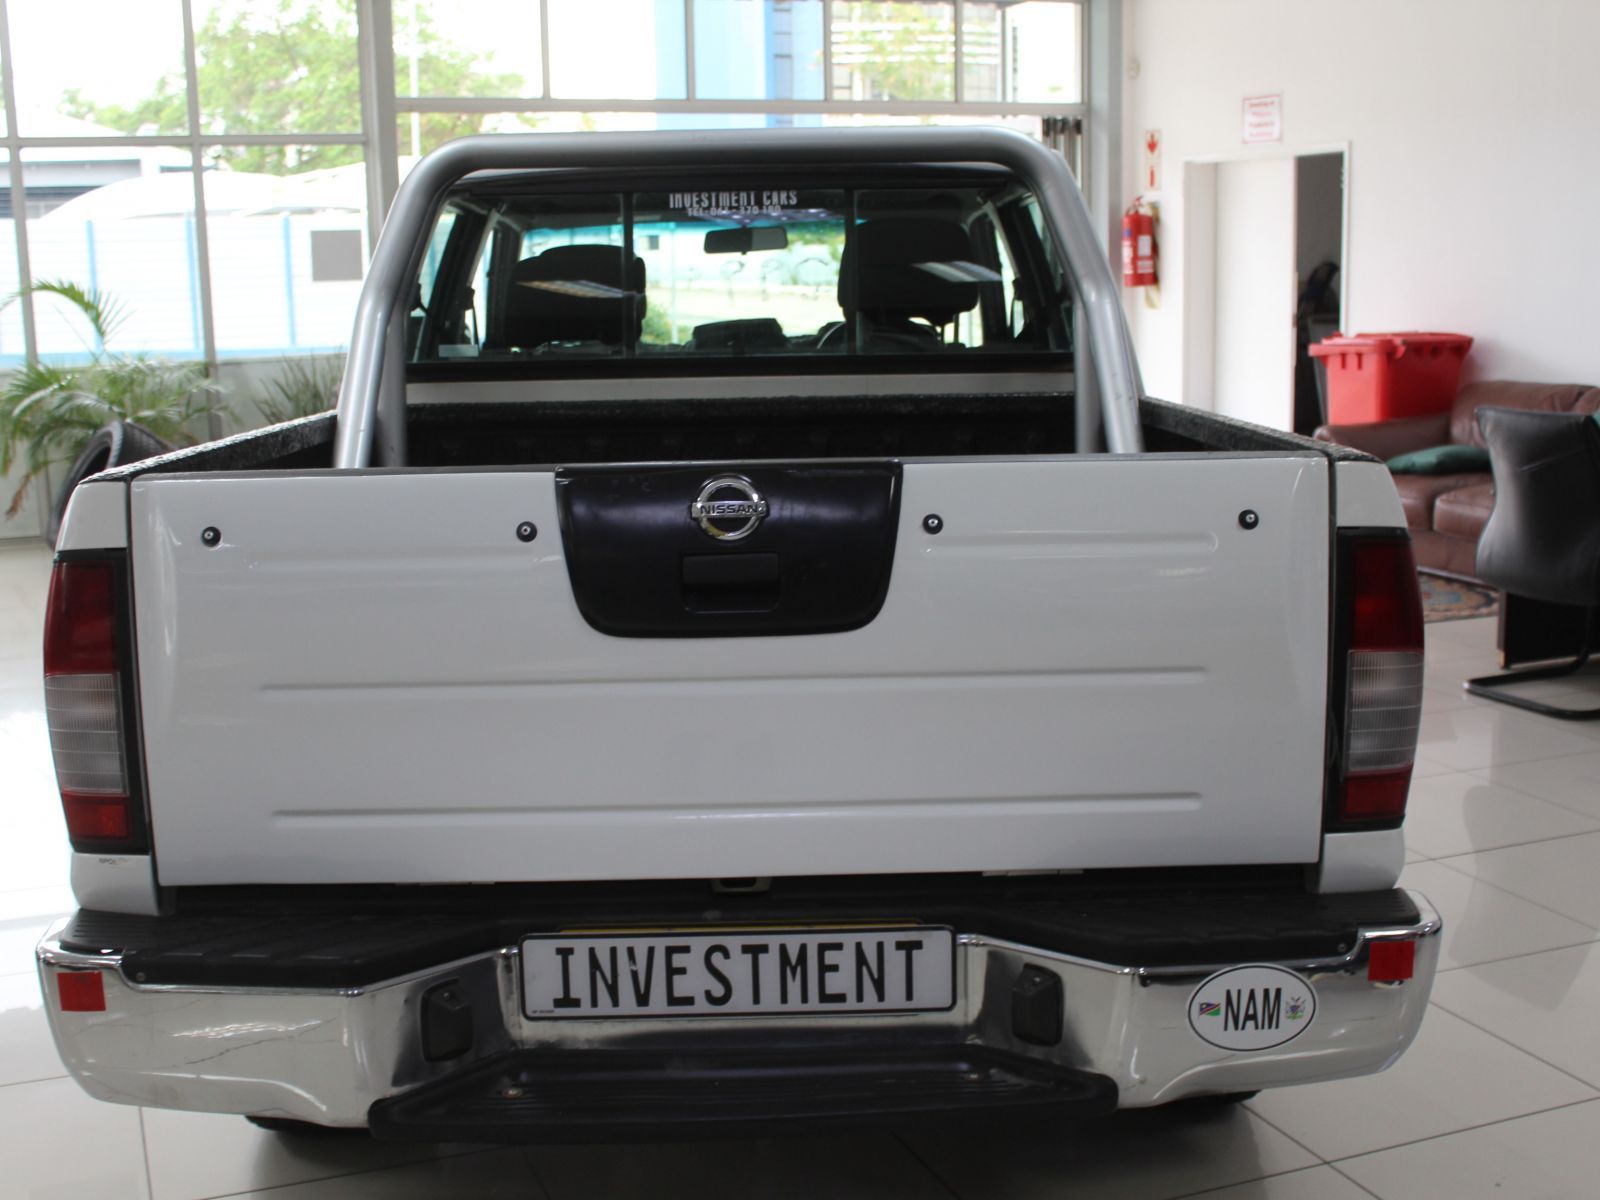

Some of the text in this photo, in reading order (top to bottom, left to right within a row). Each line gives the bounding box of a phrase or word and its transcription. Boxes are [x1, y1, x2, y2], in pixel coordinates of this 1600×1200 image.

[669, 190, 798, 208] INVESTMENT CARS
[700, 504, 758, 515] NISSAN
[552, 940, 924, 1009] INVESTMENT
[1223, 987, 1282, 1031] NAM
